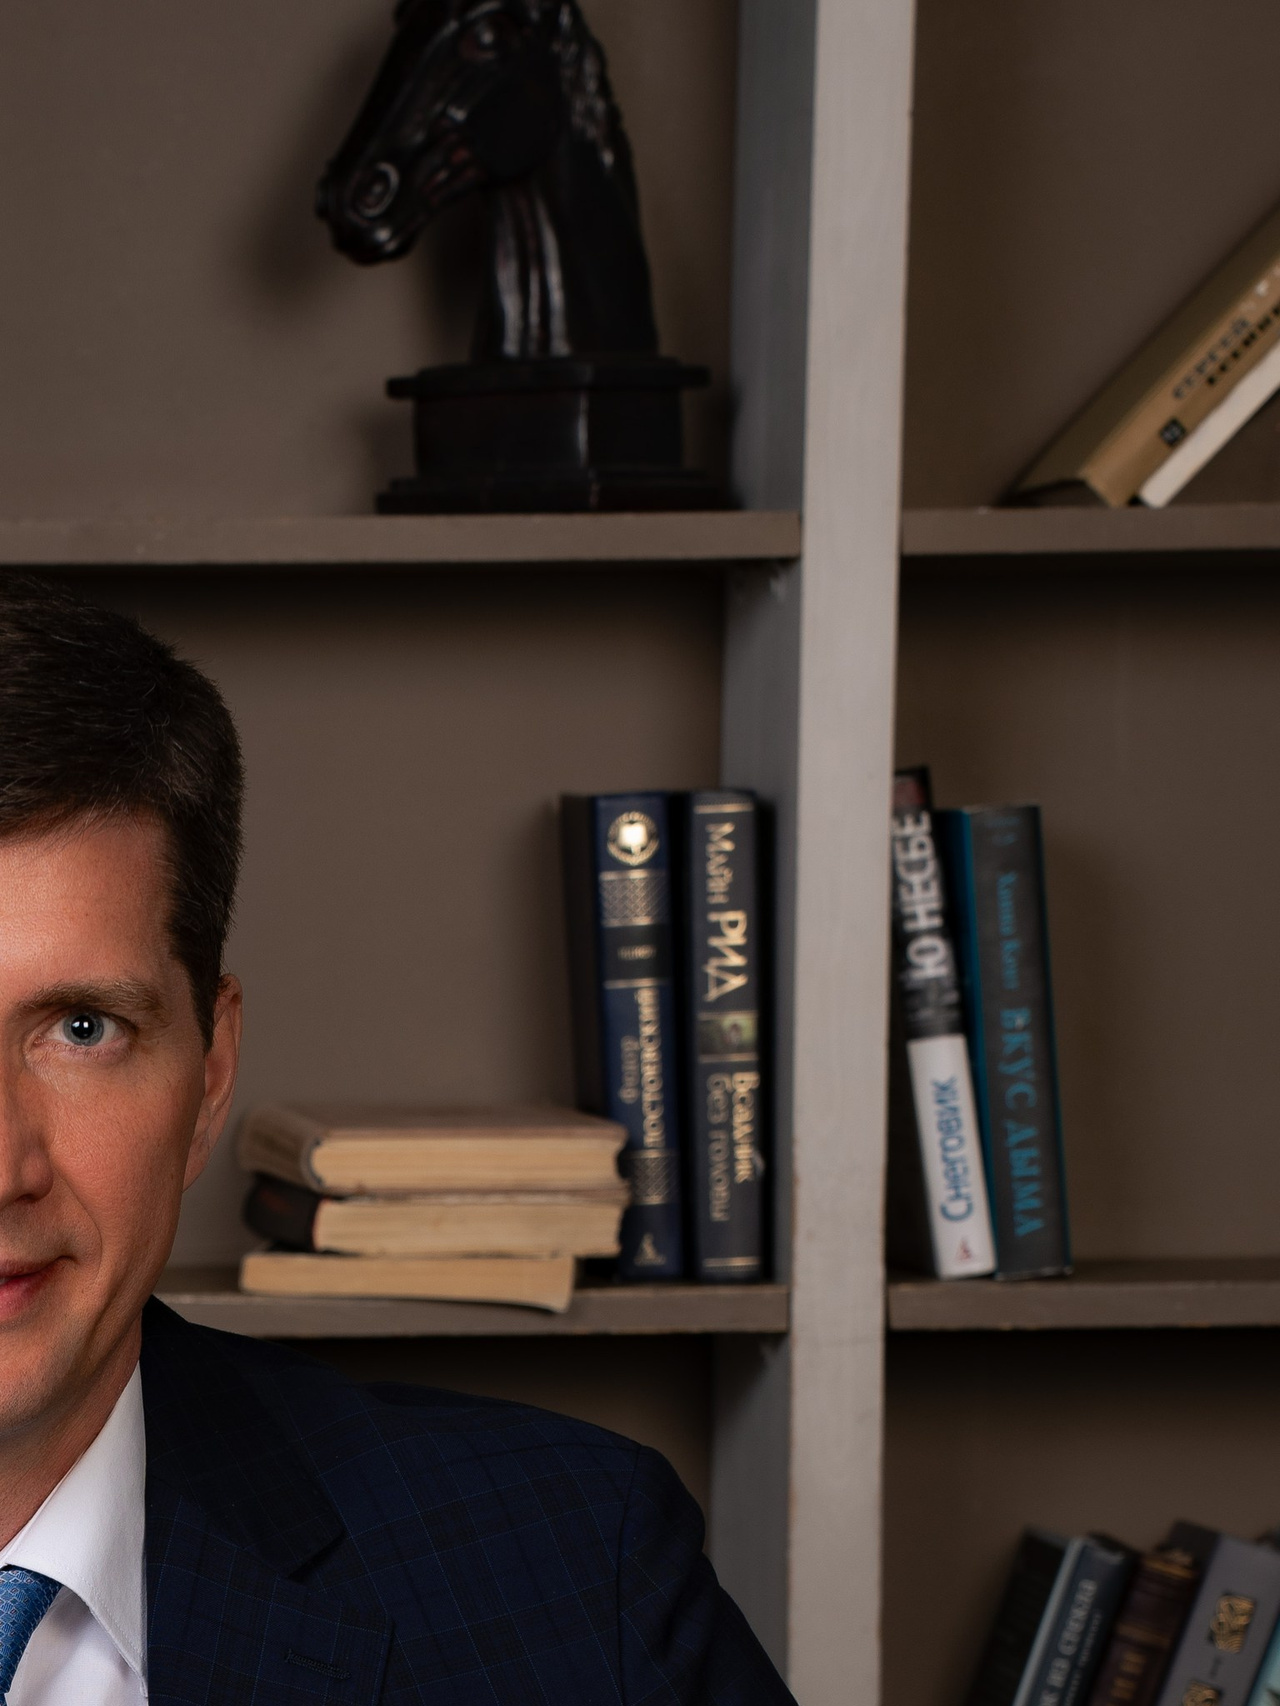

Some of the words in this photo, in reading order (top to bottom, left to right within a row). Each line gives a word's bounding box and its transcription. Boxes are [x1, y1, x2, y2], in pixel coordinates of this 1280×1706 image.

[702, 909, 749, 1003] РИД
[906, 932, 951, 981] Ю
[706, 1073, 734, 1125] без
[998, 1005, 1038, 1110] ВКУС
[707, 1129, 732, 1223] головы
[731, 1071, 761, 1185] Всадник
[931, 1075, 974, 1222] Снеговик
[1004, 1118, 1046, 1238] ДЫМА
